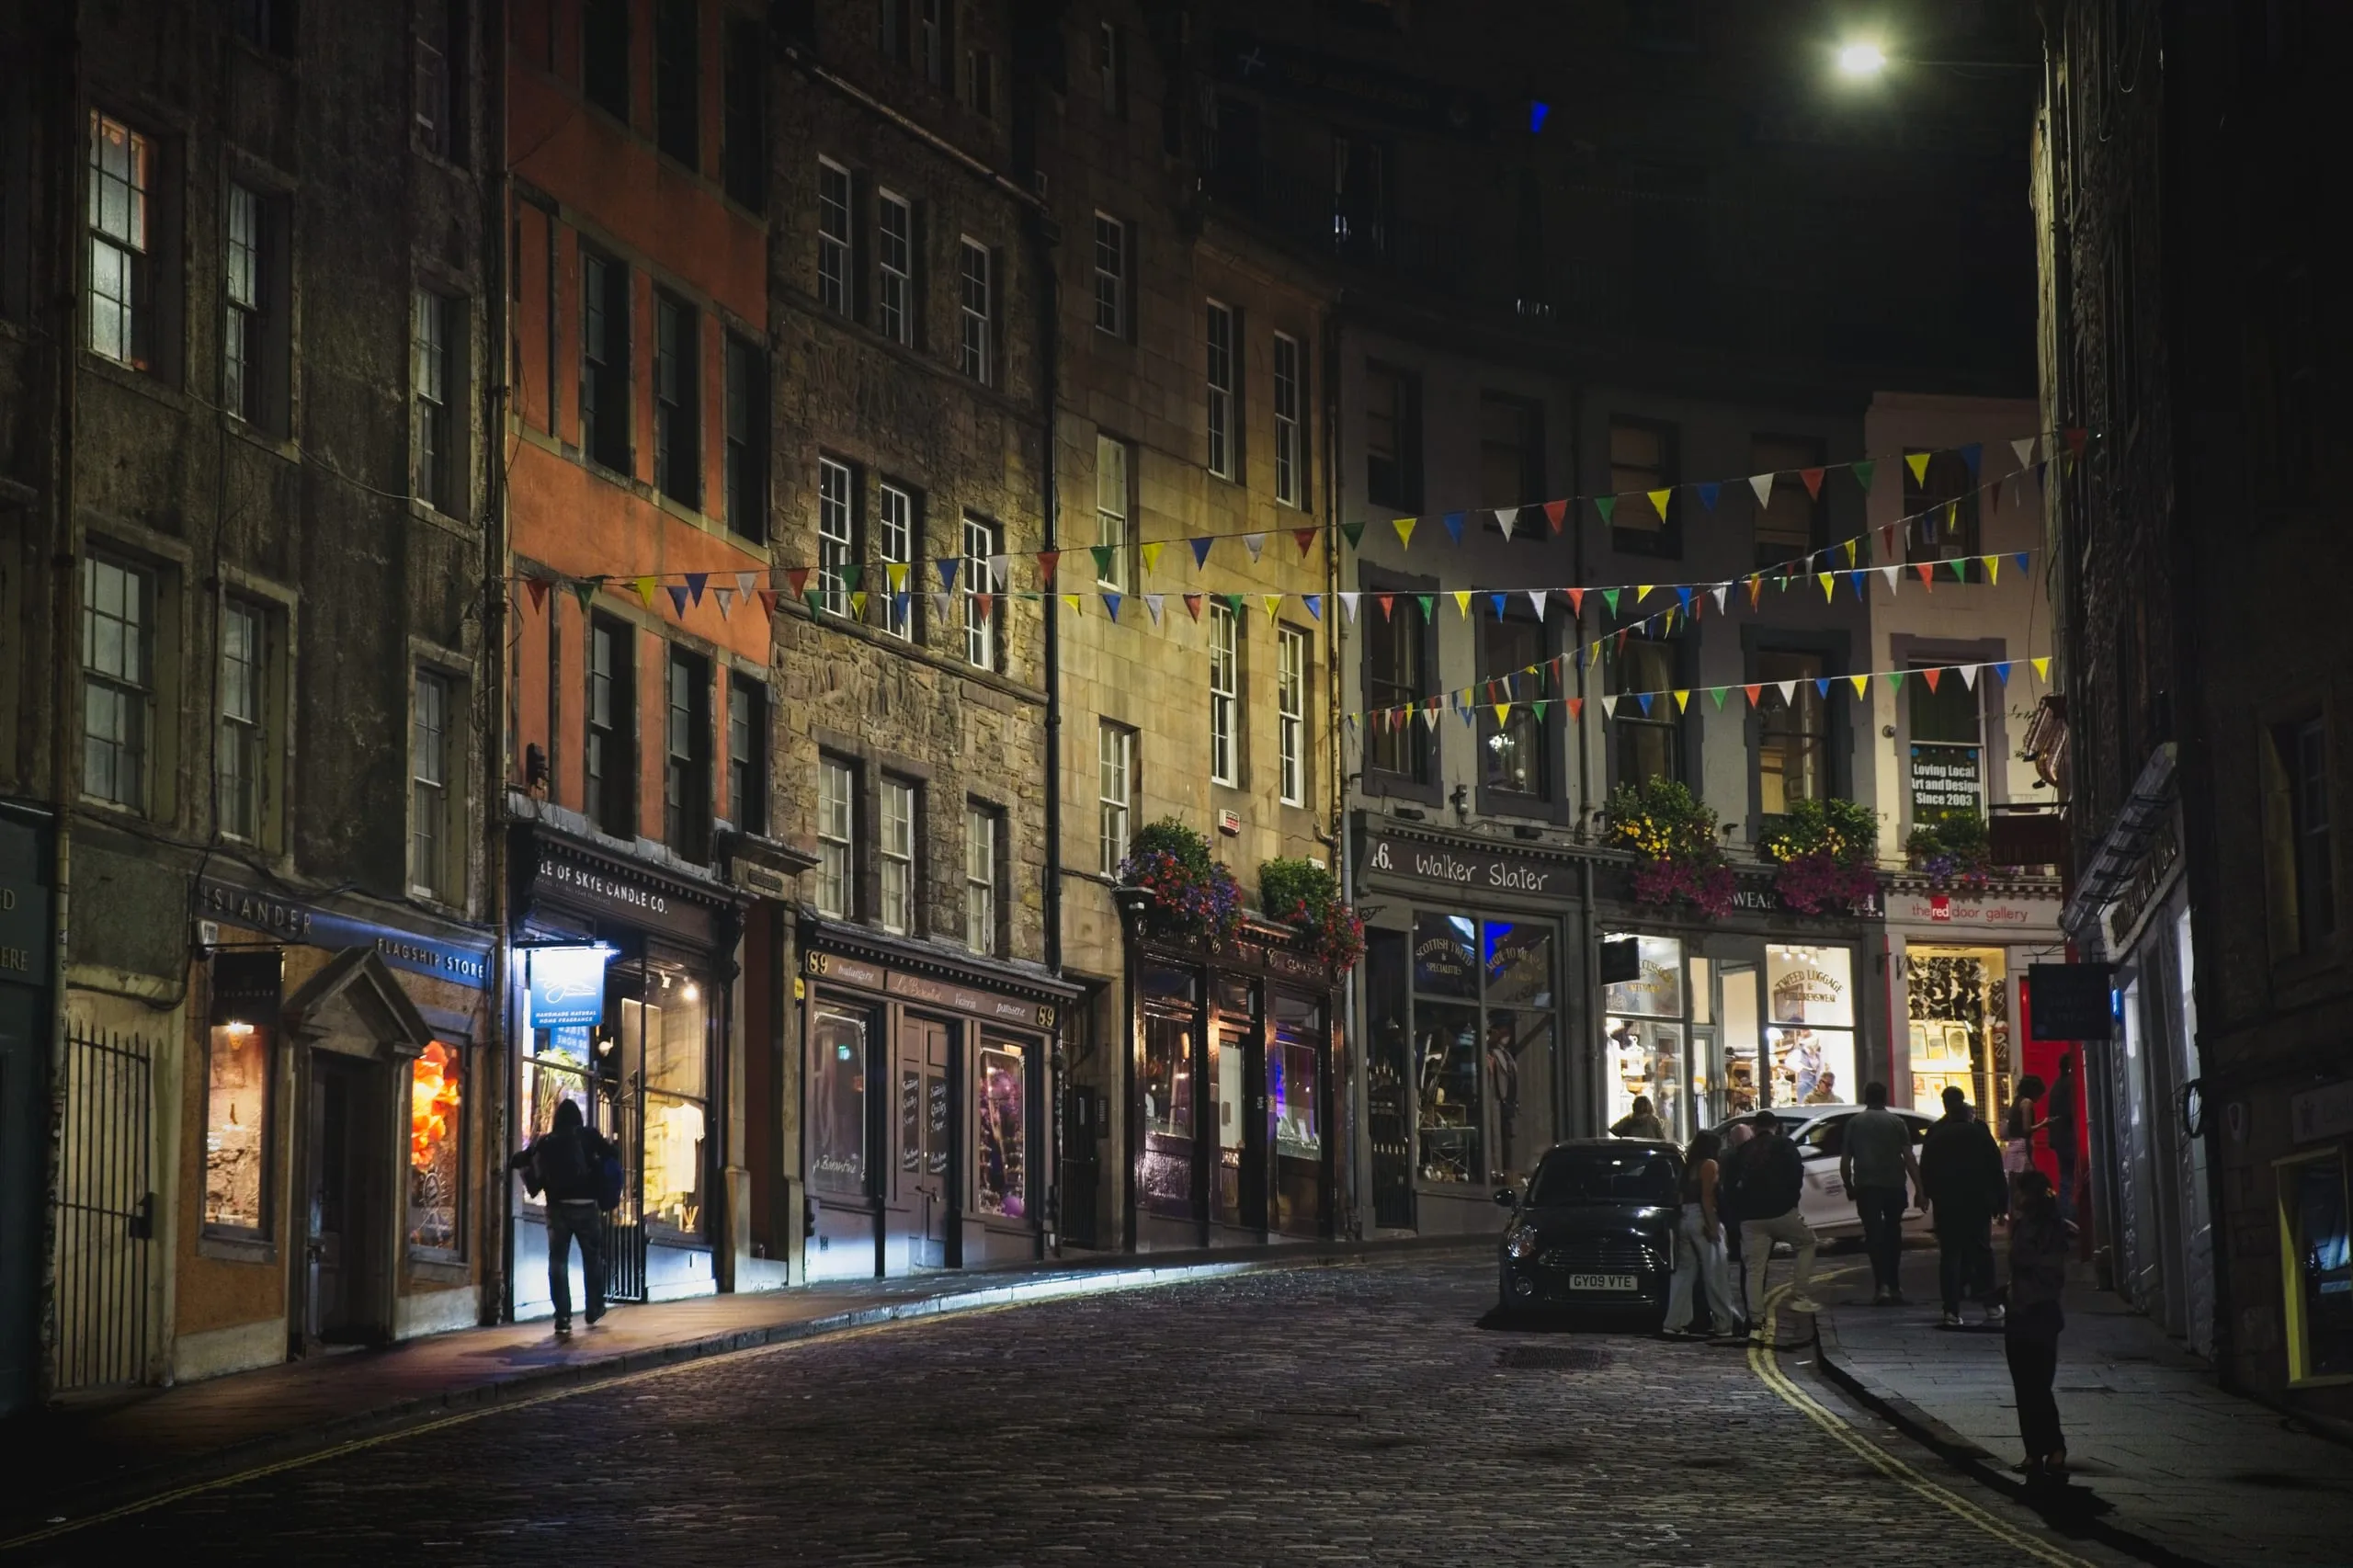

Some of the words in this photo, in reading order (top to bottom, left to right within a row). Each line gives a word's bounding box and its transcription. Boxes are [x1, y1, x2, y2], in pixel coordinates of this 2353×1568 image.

[1913, 763, 1946, 778] Loving
[1949, 765, 1975, 778] Local
[1912, 778, 1925, 790] Art
[1926, 778, 1945, 790] and
[1946, 779, 1981, 793] Design
[1915, 792, 1945, 805] Since
[1946, 793, 1973, 806] 2003
[1415, 853, 1478, 882] Walker
[1489, 861, 1549, 891] Slater
[557, 866, 571, 881] OF
[575, 869, 602, 892] SKYE
[606, 881, 647, 907] CANDLE
[650, 895, 669, 915] CO.
[1912, 903, 1930, 917] the
[1932, 903, 1949, 917] red
[1951, 904, 1980, 918] door
[1985, 906, 2029, 923] gallery
[377, 938, 441, 968] FLAGSHIP
[445, 957, 484, 979] STORE
[1415, 937, 1449, 960] SCOTTISH
[809, 952, 828, 975] 89
[1037, 1006, 1055, 1028] 89
[1775, 970, 1805, 991] TWEED
[1806, 969, 1844, 994] LUGGAGE
[1574, 1275, 1605, 1287] GY09
[1608, 1276, 1631, 1288] VTE
